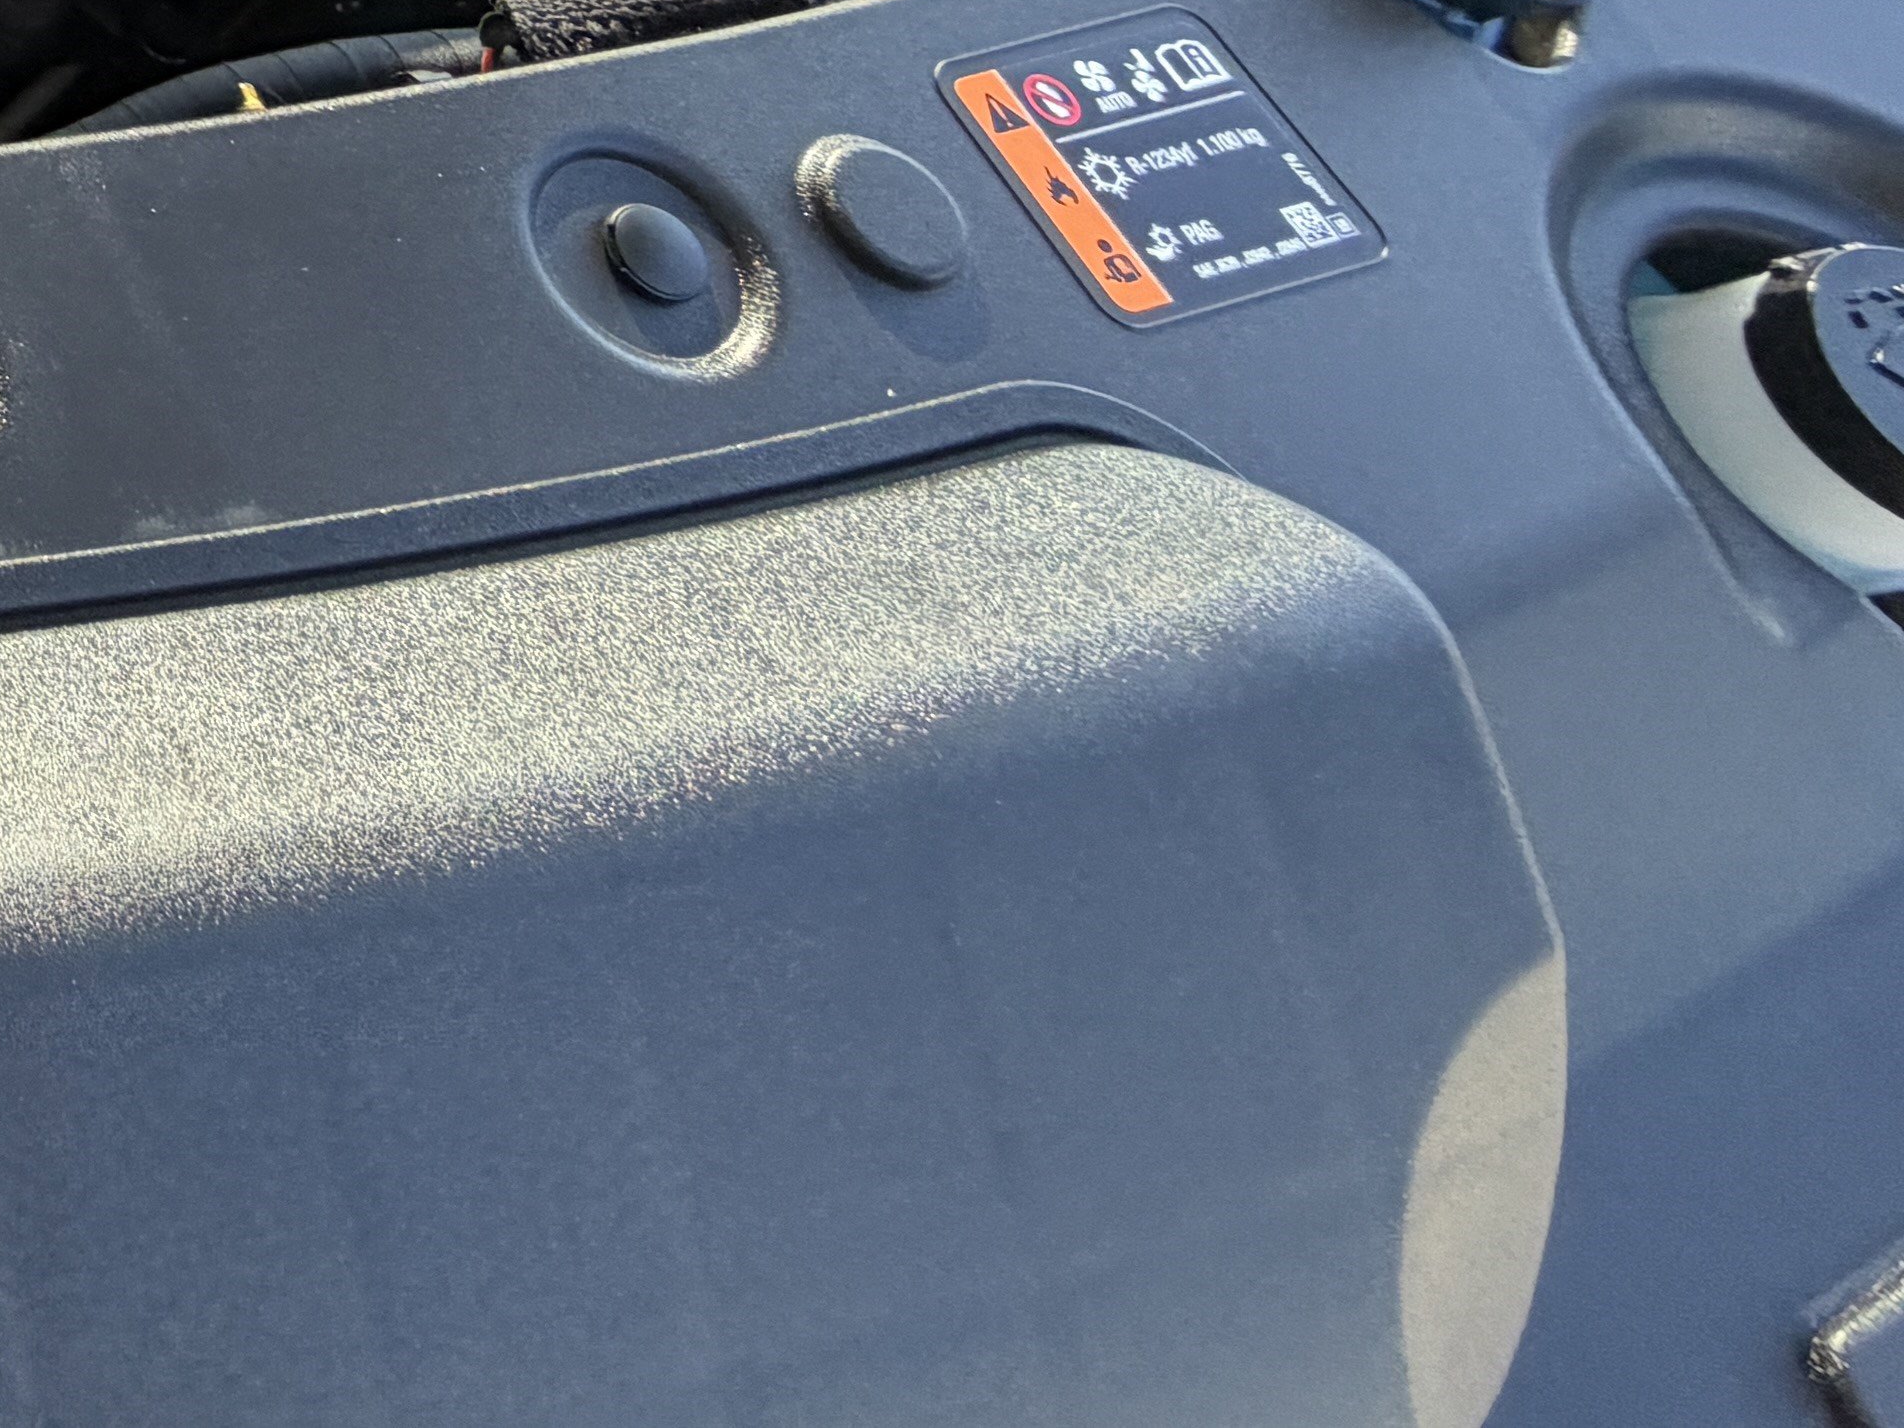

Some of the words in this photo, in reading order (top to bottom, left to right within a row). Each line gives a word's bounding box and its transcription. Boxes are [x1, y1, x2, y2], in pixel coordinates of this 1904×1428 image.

[1095, 91, 1138, 114] AUTO
[1124, 142, 1198, 175] R-1234yf
[1235, 127, 1270, 148] kg
[1179, 219, 1225, 246] PAG
